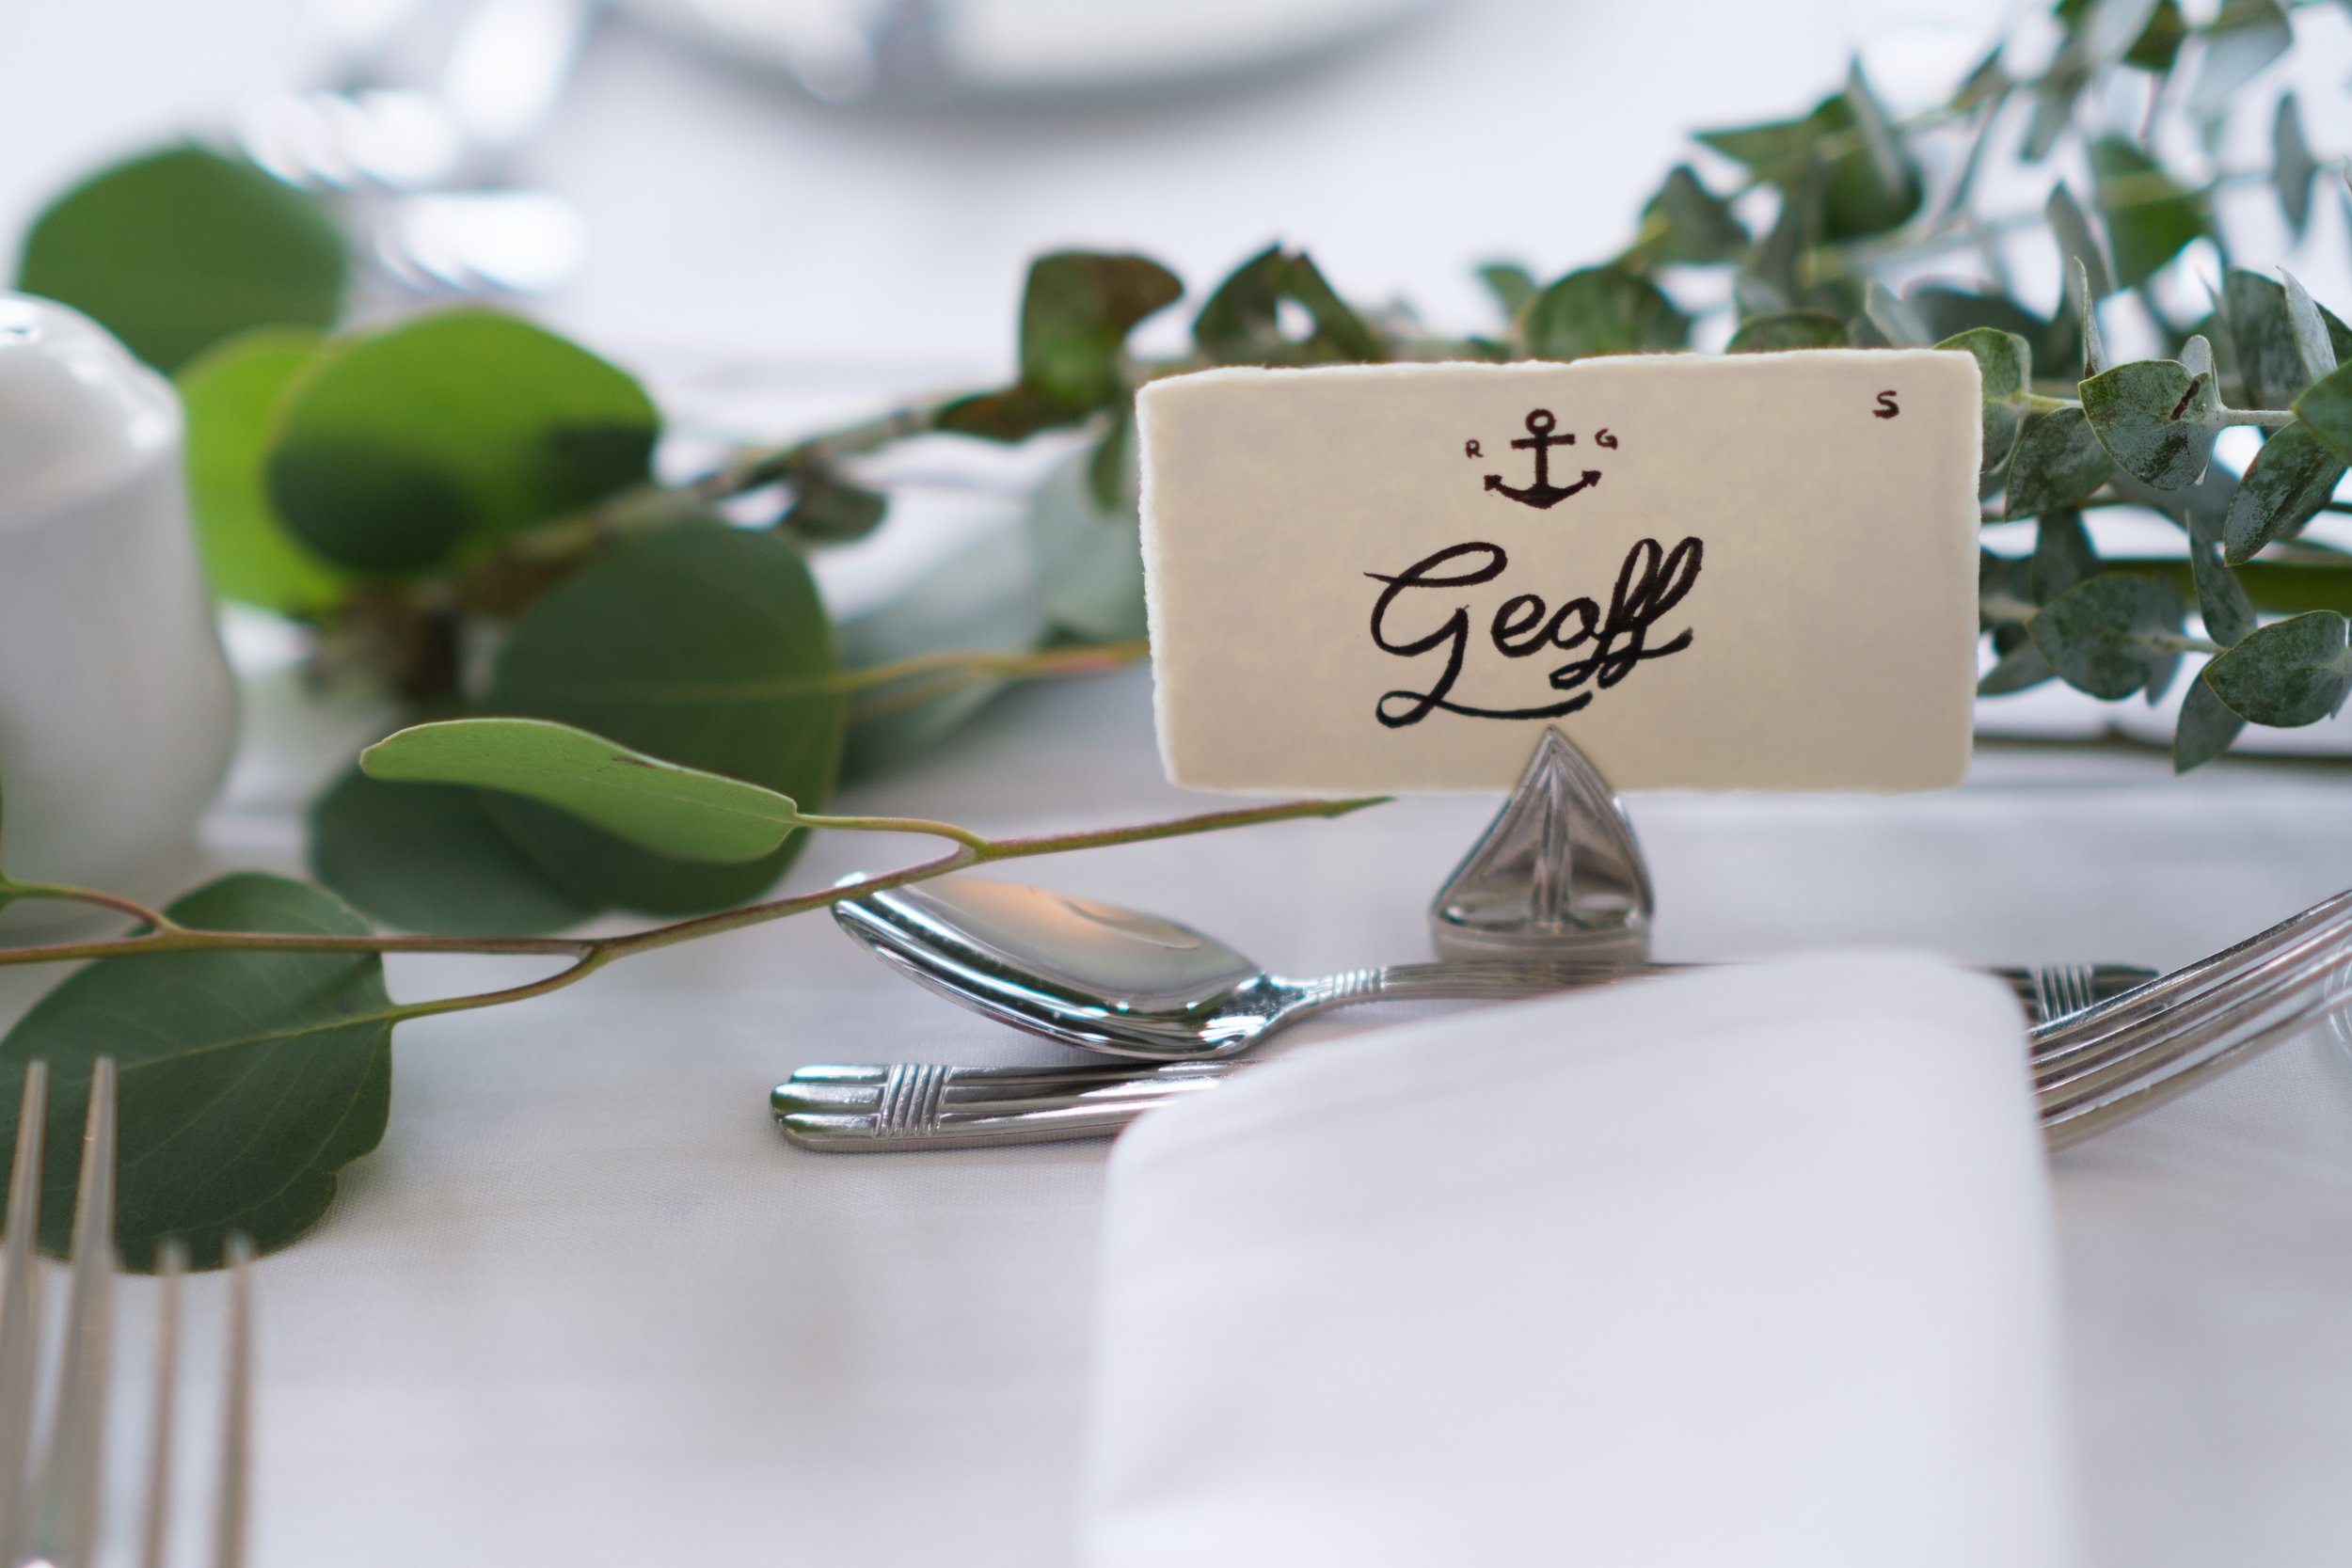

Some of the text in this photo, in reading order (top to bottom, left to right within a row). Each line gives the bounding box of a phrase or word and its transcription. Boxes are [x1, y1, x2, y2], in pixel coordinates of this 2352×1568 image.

[1871, 389, 1900, 420] S
[1464, 428, 1619, 459] R G
[1363, 535, 1705, 729] Geoff
